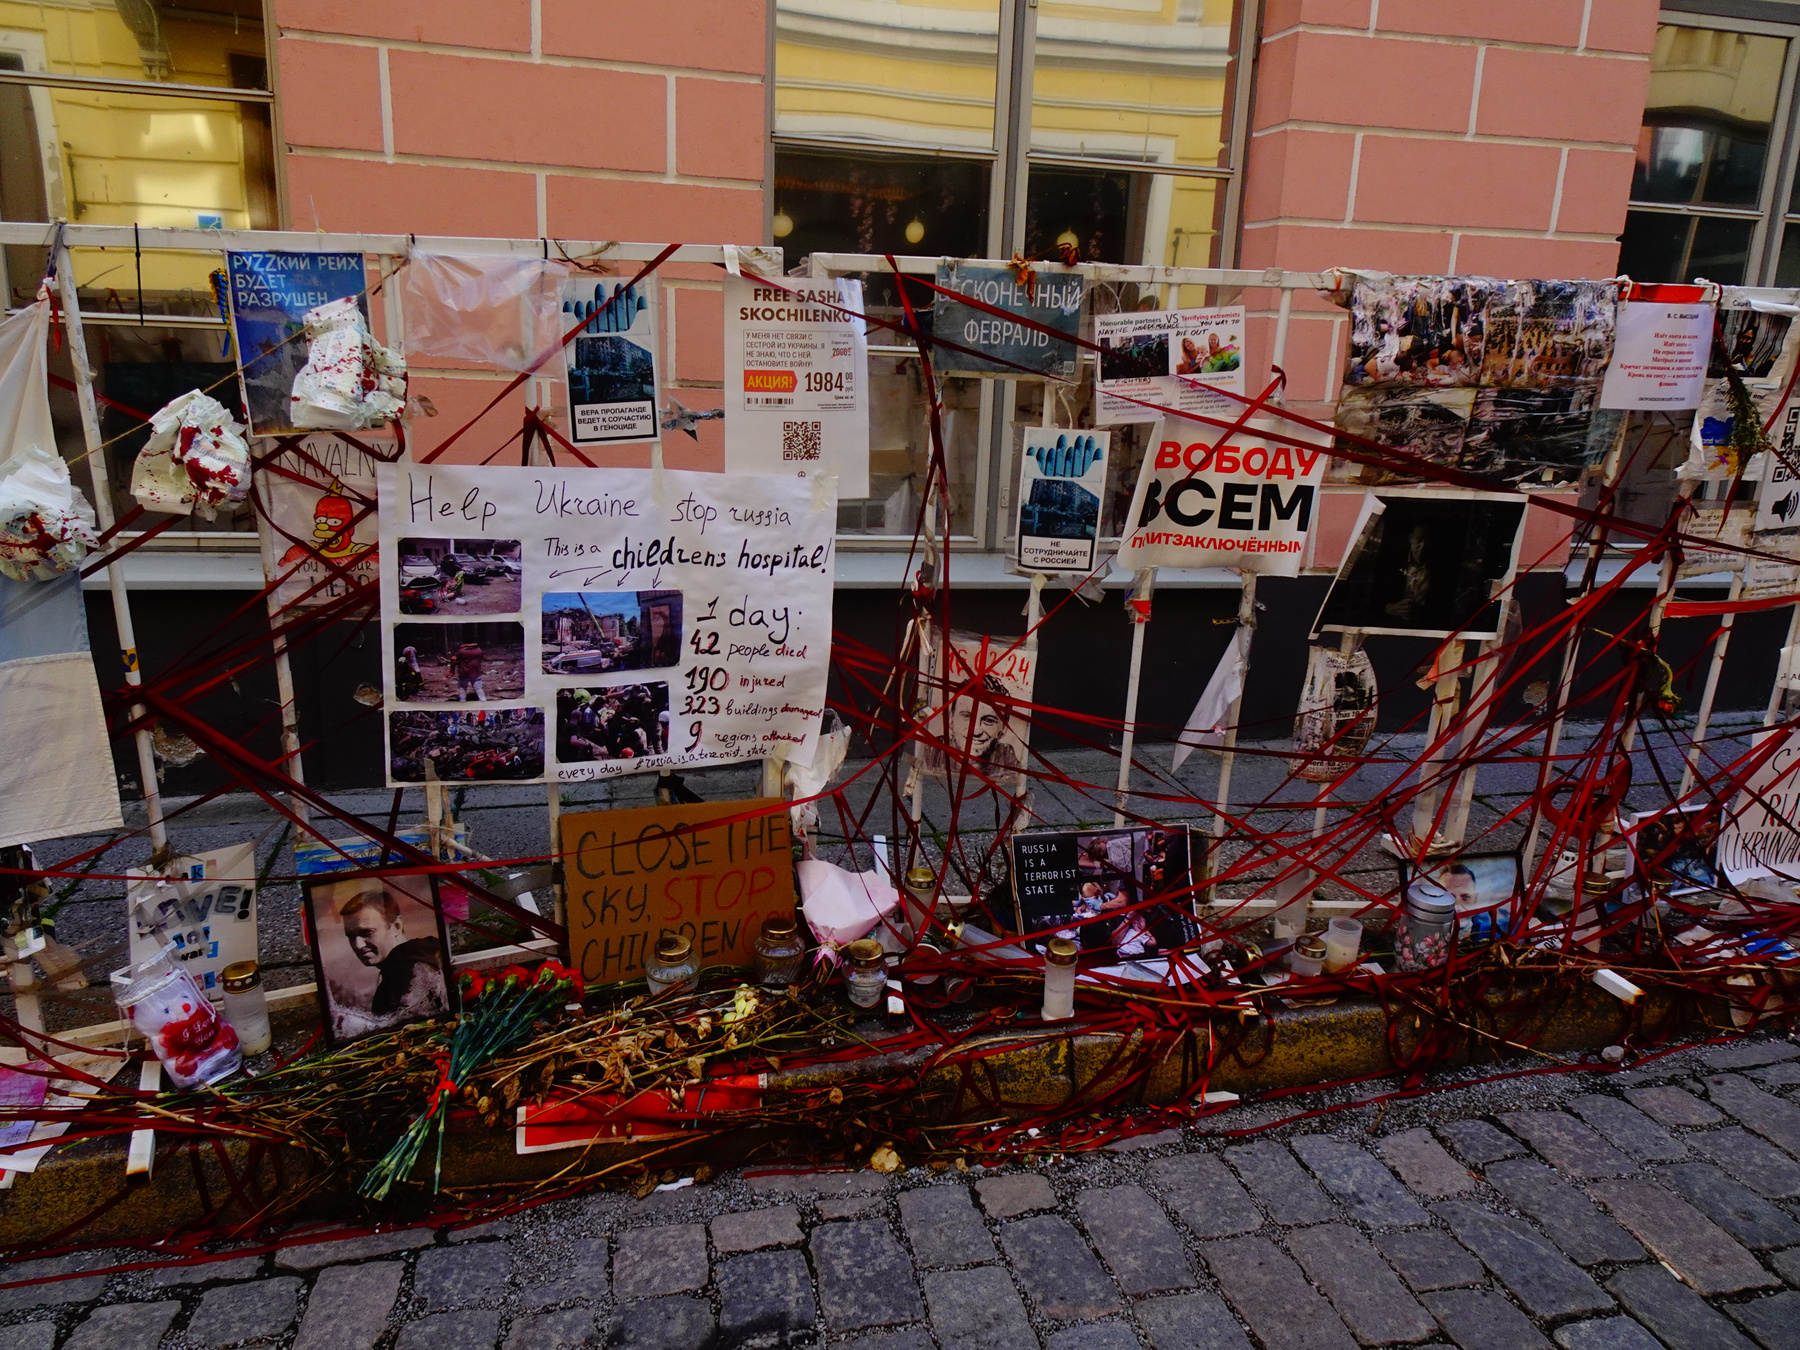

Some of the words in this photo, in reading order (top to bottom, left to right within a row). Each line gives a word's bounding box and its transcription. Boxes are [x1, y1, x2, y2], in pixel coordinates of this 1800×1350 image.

[233, 254, 311, 272] РУZZКИЙ
[318, 254, 360, 271] РЕЙХ
[235, 274, 286, 290] БУДЕТ
[238, 292, 328, 307] РАЗРУШЕН
[754, 288, 791, 302] FREE
[797, 289, 846, 304] SASHA
[1100, 318, 1133, 327] Honorable
[1135, 317, 1161, 325] partners
[1166, 313, 1179, 323] VS
[964, 319, 1049, 347] ФЕВРАЛЬ
[746, 341, 775, 349] СЕСТРОЙ
[788, 342, 819, 350] УКРАИНЫ.
[756, 351, 777, 359] ЗНАЮ,
[798, 351, 812, 359] НЕЙ.
[790, 360, 813, 368] ВОЙНУ!
[747, 375, 793, 389] АКЦИЯ!
[805, 372, 844, 392] 1984
[845, 371, 853, 380] 00
[608, 414, 652, 422] СОУЧАСТИЮ
[600, 423, 637, 431] ГЕНОЦИДЕ
[1154, 441, 1320, 480] ВОБОДУ
[407, 472, 497, 530] Help
[534, 479, 640, 517] Ukraine
[670, 492, 718, 535] stop
[728, 506, 791, 527] russia
[1138, 478, 1315, 532] ВСЕМ
[544, 538, 569, 557] This
[573, 543, 584, 556] is
[590, 545, 602, 554] a
[737, 537, 832, 574] hospital!
[1024, 547, 1088, 557] СОТРУДНИЧАЙТЕ
[1041, 557, 1077, 565] РОССИЕЙ
[696, 596, 720, 622] 1
[728, 594, 802, 645] day:
[690, 629, 721, 656] 42
[726, 643, 770, 663] people
[775, 644, 807, 659] died
[684, 665, 730, 695] 190
[739, 675, 786, 693] injured
[679, 696, 722, 717] 323
[725, 698, 779, 721] buildings
[780, 703, 823, 721] damaged
[684, 720, 703, 753] 9
[714, 731, 757, 749] regions
[762, 732, 807, 746] attacked
[558, 765, 595, 782] every
[600, 763, 623, 775] day
[576, 822, 713, 880] CLOSE
[727, 814, 788, 864] THE
[1022, 843, 1057, 854] RUSSIA
[1024, 858, 1036, 868] IS
[1040, 858, 1046, 867] A
[1024, 869, 1077, 882] TERRORIST
[581, 883, 652, 930] SKY,
[663, 866, 777, 921] STOP
[1025, 884, 1055, 896] STATE
